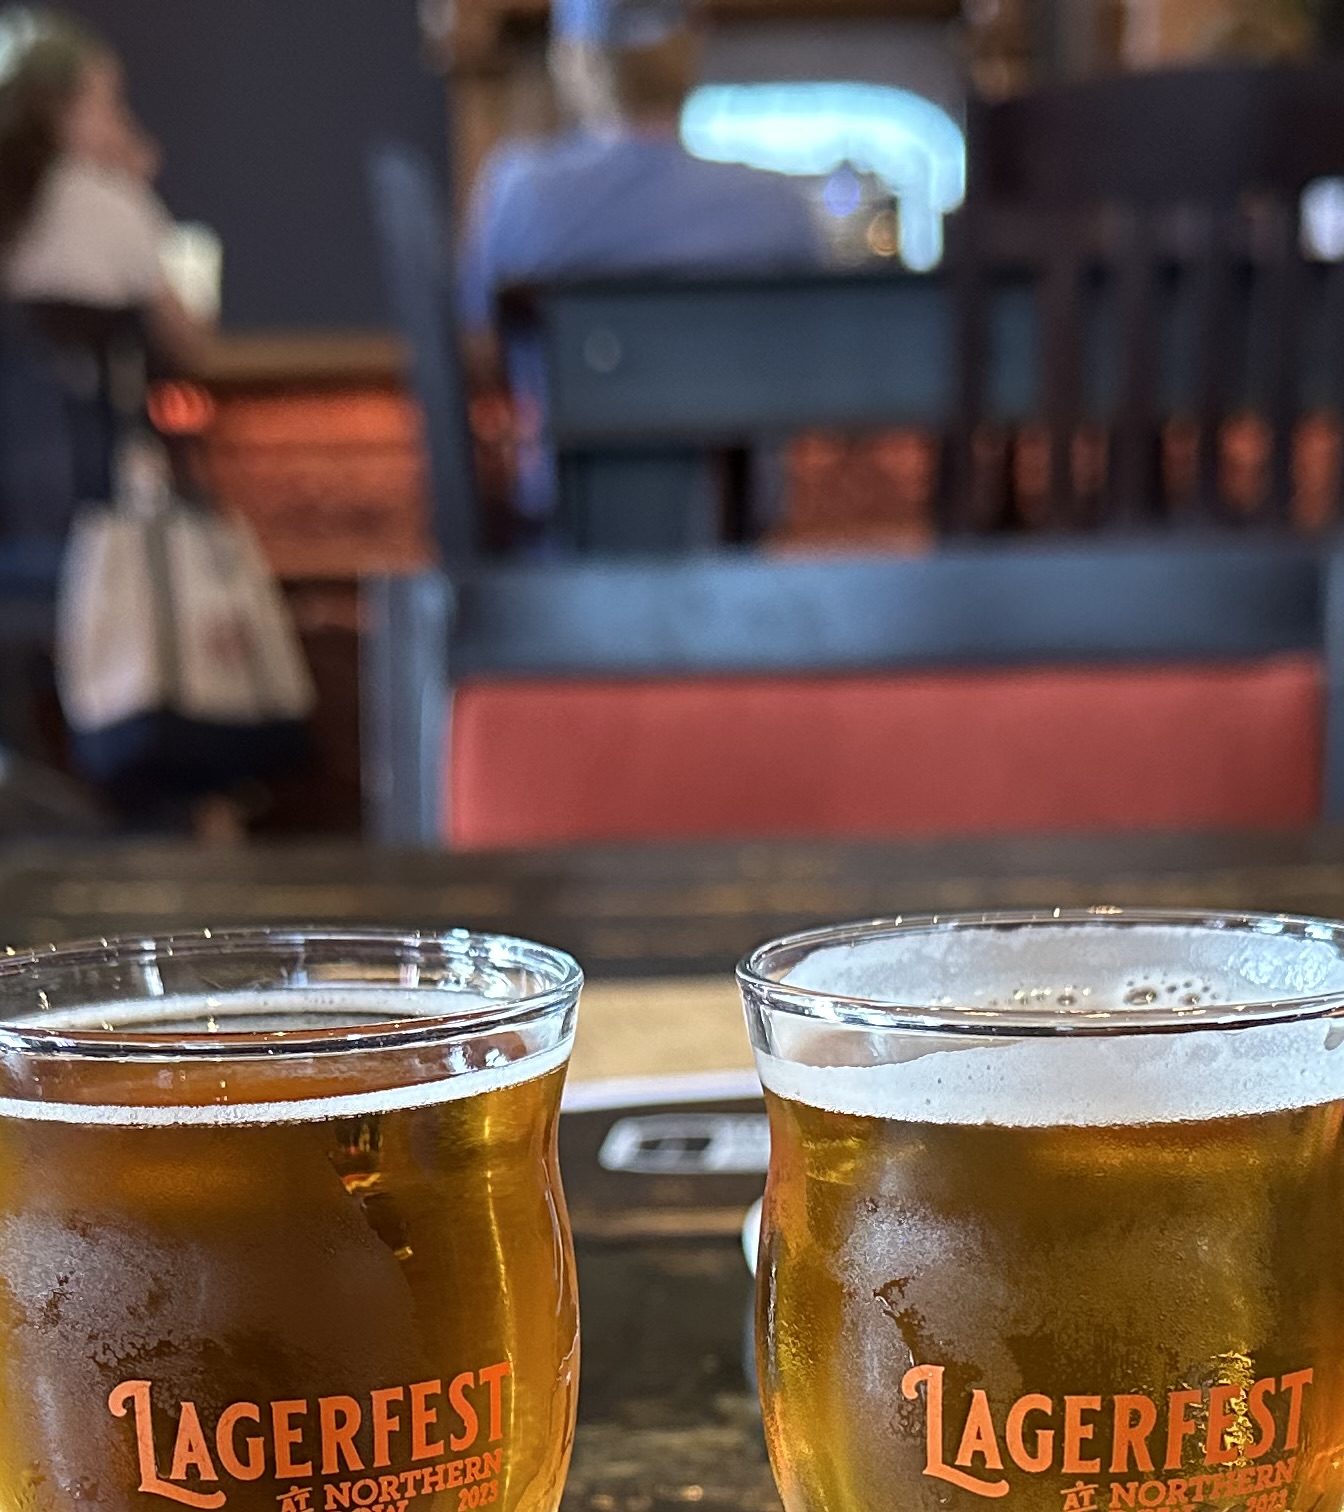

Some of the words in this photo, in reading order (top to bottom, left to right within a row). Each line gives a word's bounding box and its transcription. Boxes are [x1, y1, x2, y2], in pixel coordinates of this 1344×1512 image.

[108, 1361, 510, 1510] LAGERFEST
[324, 1447, 503, 1511] NORTHERN
[901, 1364, 1314, 1498] LAGERFEST
[1109, 1456, 1297, 1512] NORTHERN
